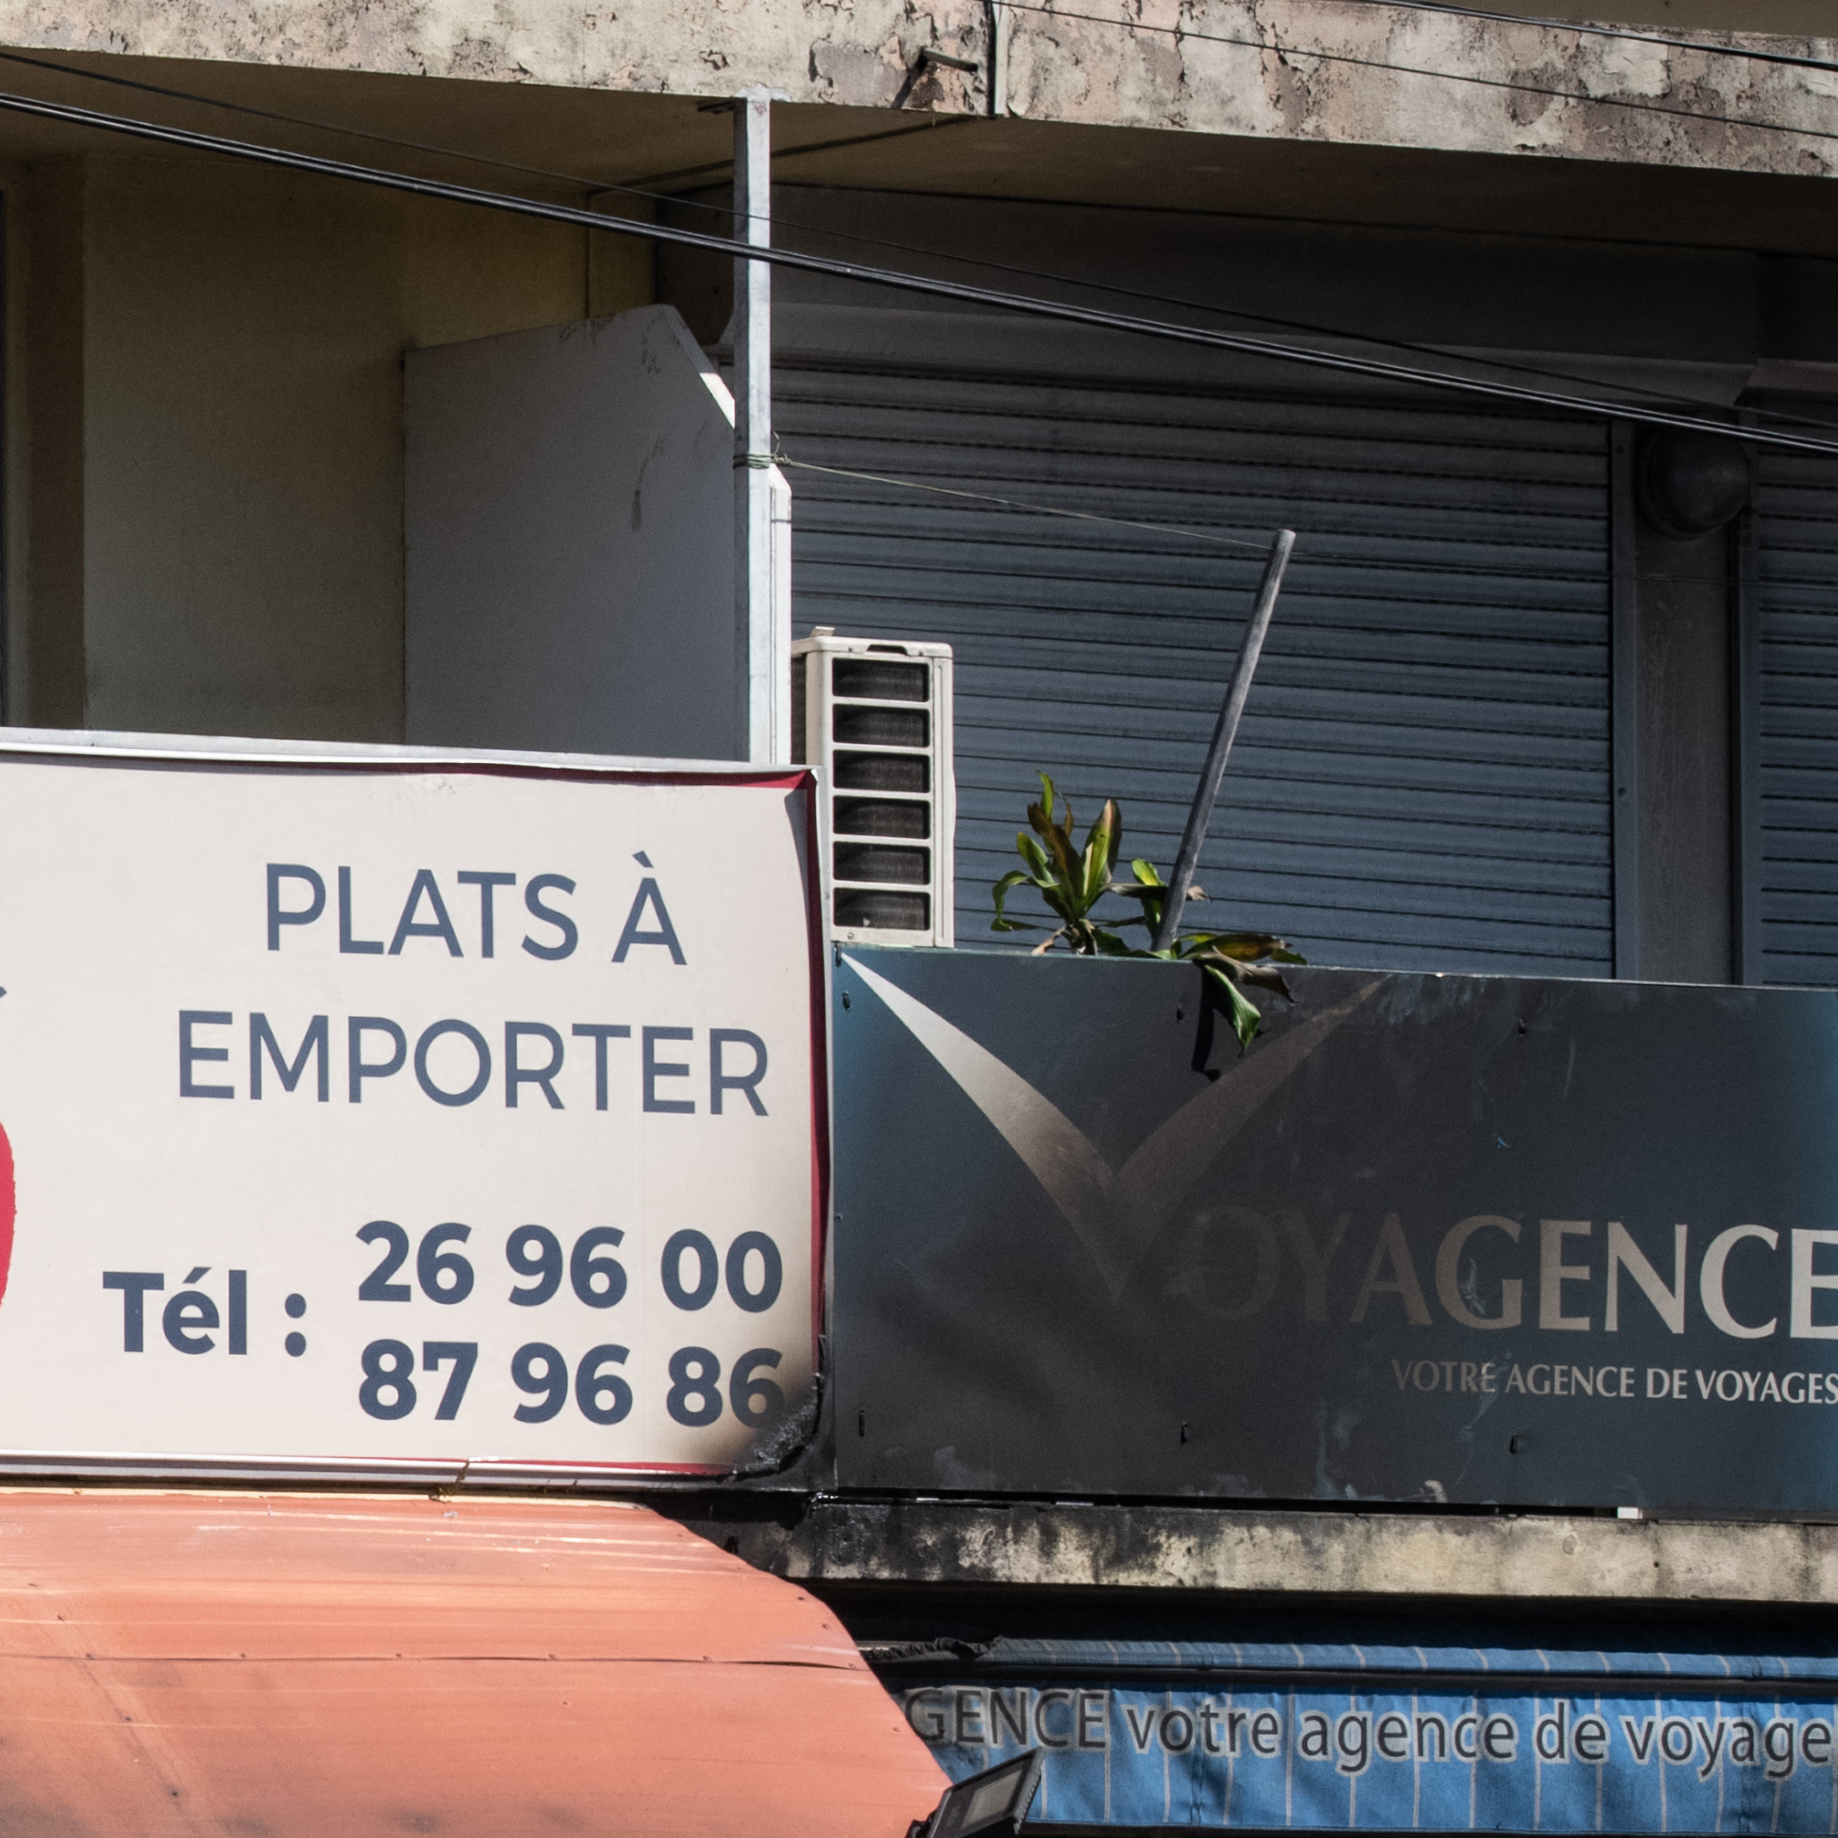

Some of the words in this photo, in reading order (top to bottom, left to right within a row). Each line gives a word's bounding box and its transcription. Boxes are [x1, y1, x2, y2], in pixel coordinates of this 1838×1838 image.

[267, 864, 577, 961] PLATS
[612, 851, 686, 966] À
[180, 1011, 768, 1117] EMPORTER
[356, 1221, 474, 1304] 26
[506, 1225, 627, 1309] 96
[661, 1229, 782, 1313] 00
[359, 1338, 477, 1421] 87
[512, 1343, 633, 1426] 96
[666, 1346, 787, 1429] 86
[1392, 1359, 1495, 1393] VOTRE
[1505, 1364, 1635, 1398] AGENCE
[1646, 1369, 1688, 1400] DE
[1695, 1370, 1838, 1405] VOYAGES
[1126, 1702, 1280, 1754] votre
[1300, 1709, 1514, 1775] agence
[1536, 1701, 1607, 1760] de
[1624, 1718, 1832, 1779] voyage
